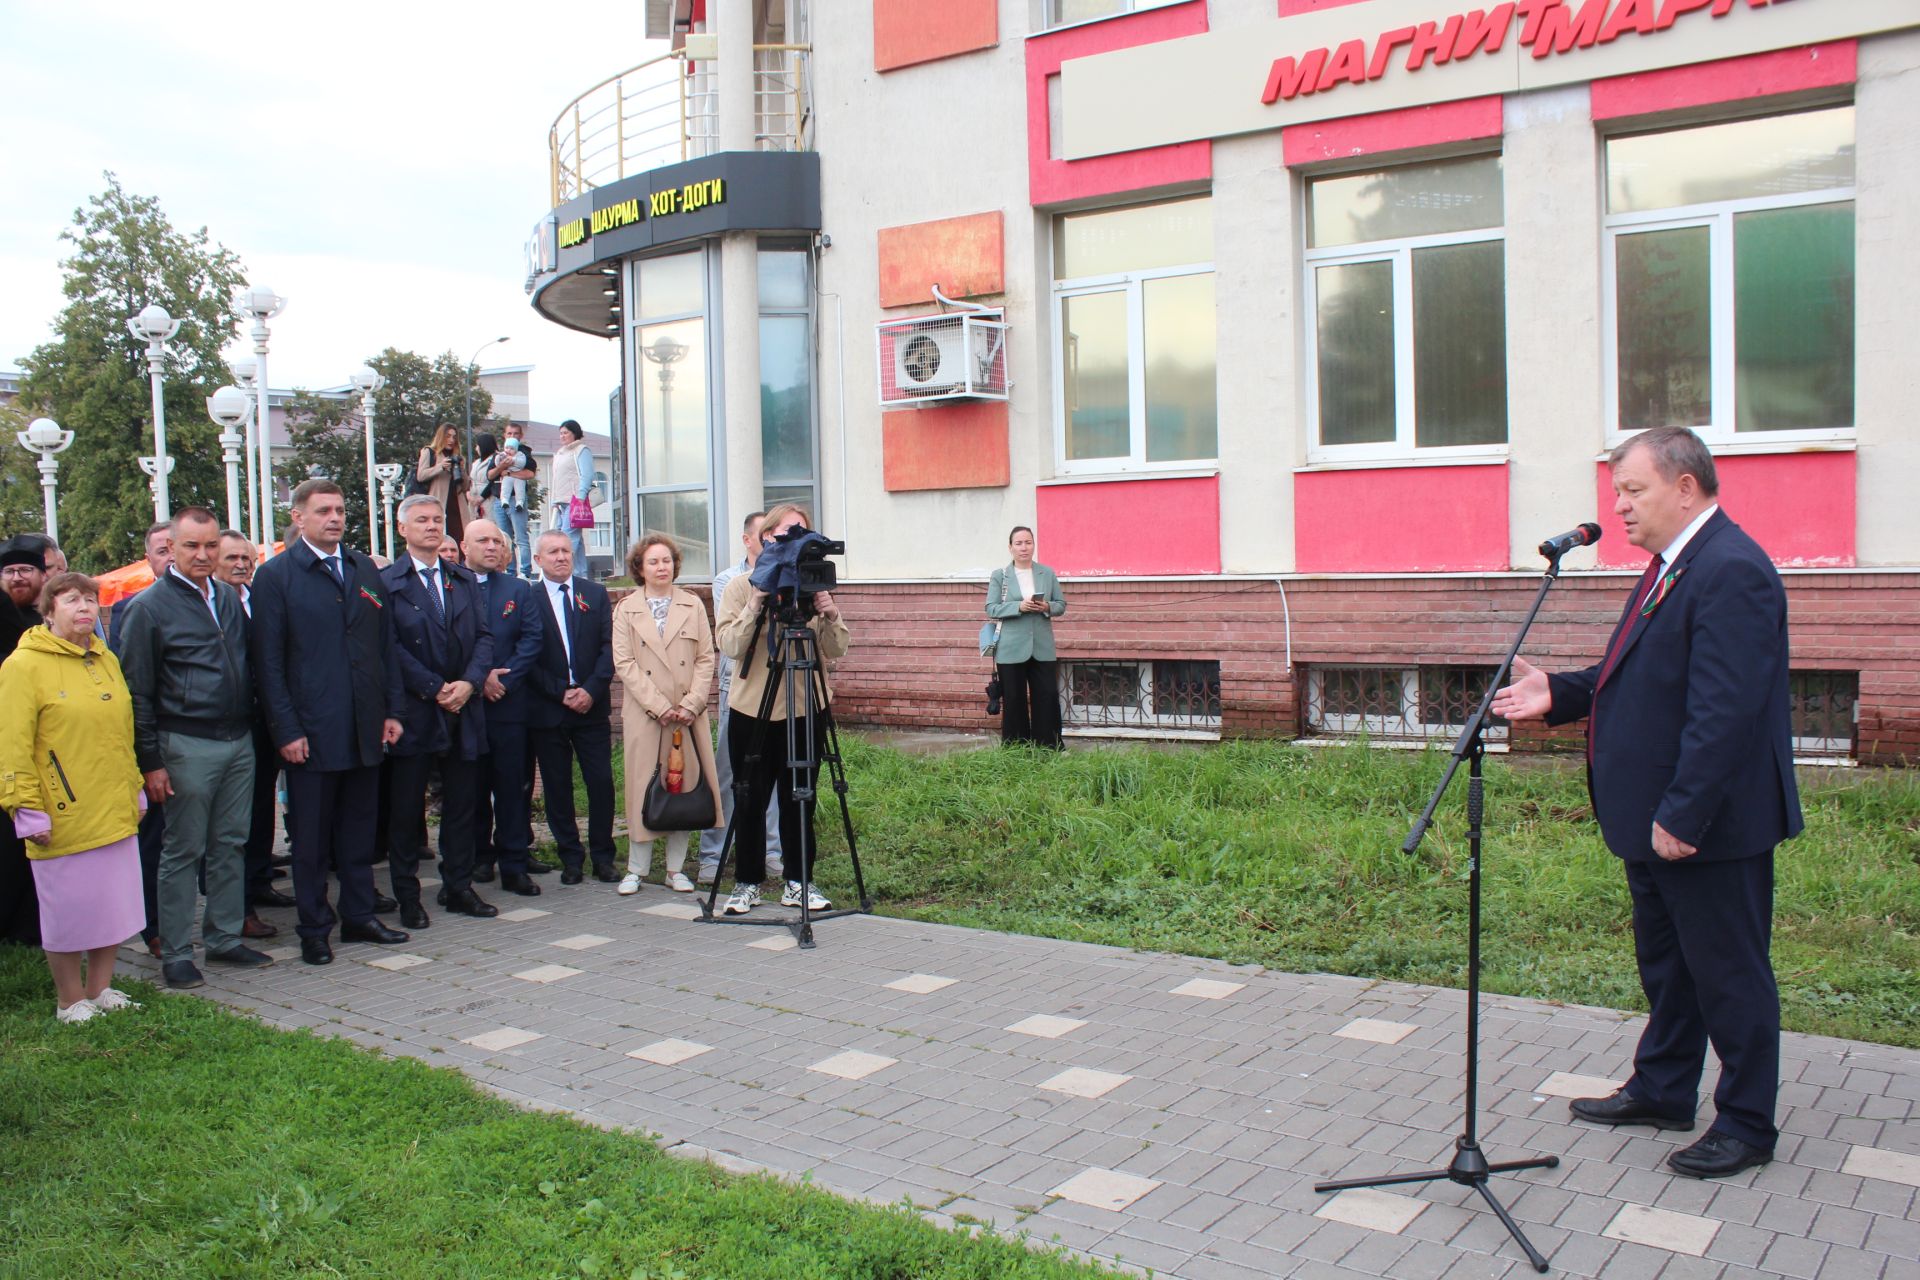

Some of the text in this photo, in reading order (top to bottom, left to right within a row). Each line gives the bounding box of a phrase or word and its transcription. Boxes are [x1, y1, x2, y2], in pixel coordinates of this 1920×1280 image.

[559, 178, 722, 249] ПИЦЦА ШАУРМА ХОТ-ДОГИ
